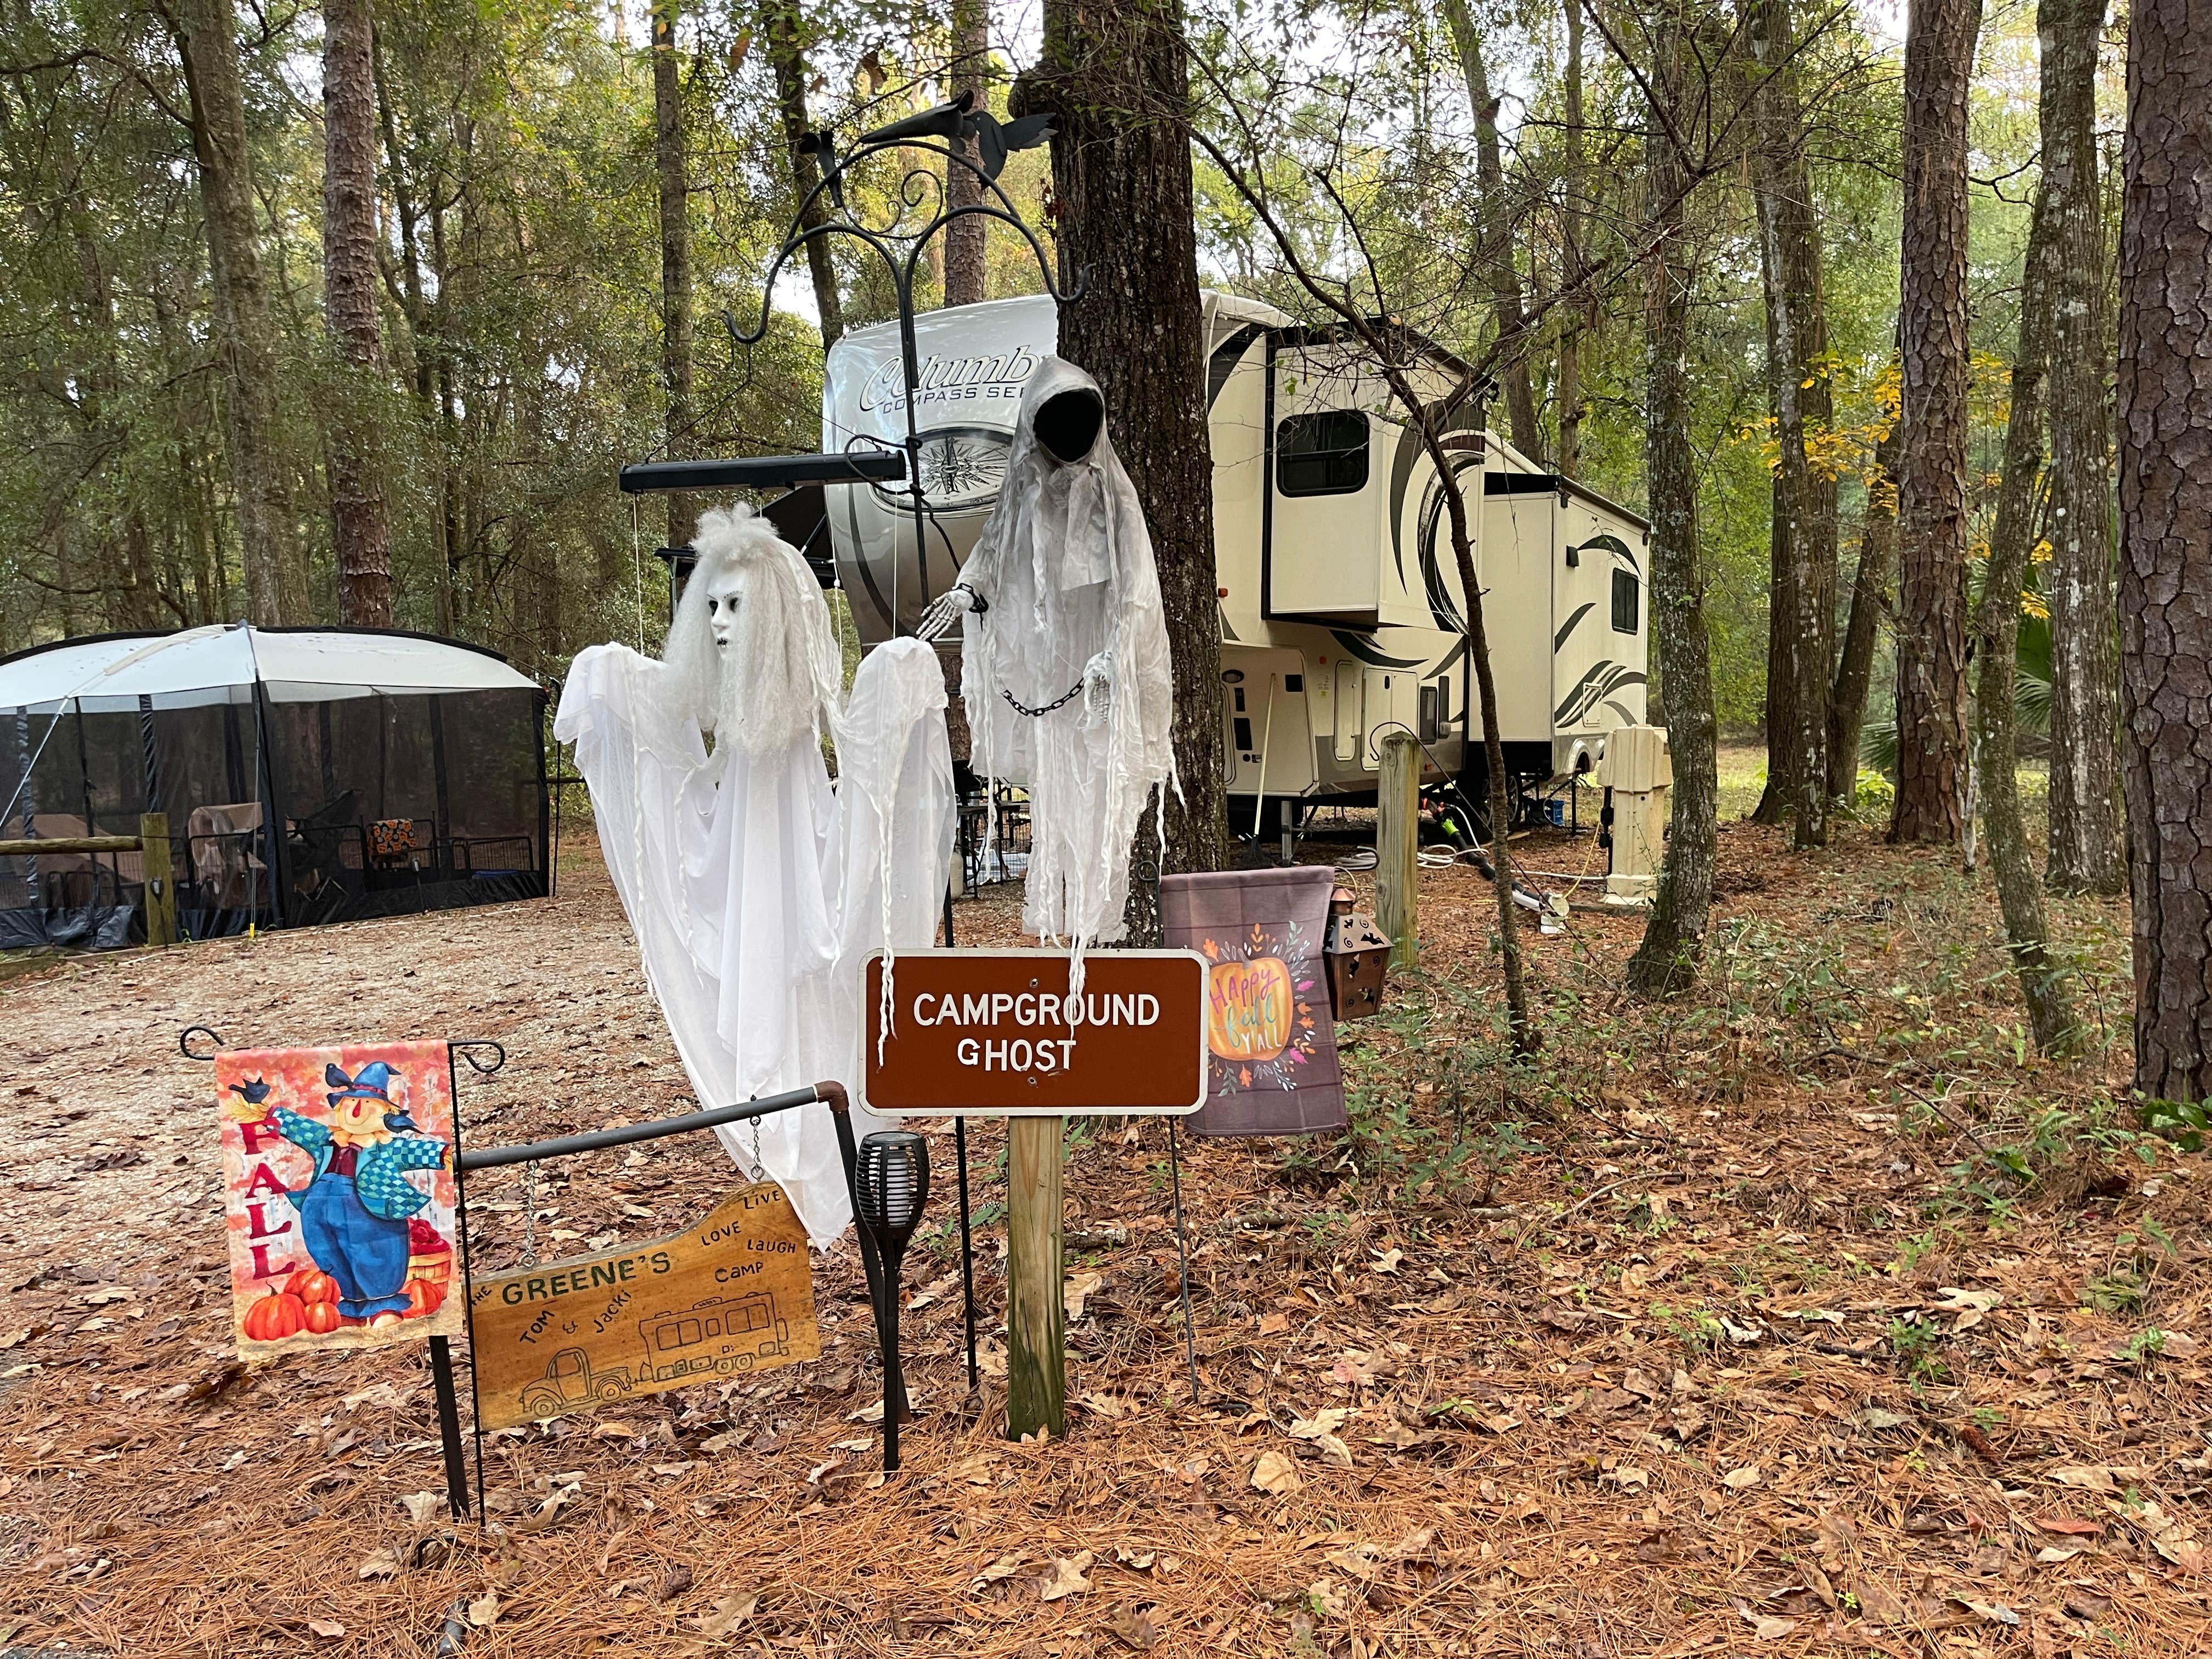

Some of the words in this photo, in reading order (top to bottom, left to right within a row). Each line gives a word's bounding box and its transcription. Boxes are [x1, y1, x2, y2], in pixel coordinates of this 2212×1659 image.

[860, 345, 1055, 411] Columb
[913, 993, 1160, 1026] CAMPGROUND
[1214, 992, 1277, 1048] fall
[957, 1038, 1076, 1072] GHOST
[1241, 1025, 1282, 1054] Y'ALL
[238, 1121, 296, 1280] FALL
[701, 1221, 742, 1246] LOVE
[502, 1251, 671, 1305] GREENE'S
[519, 1310, 555, 1344] TOM
[562, 1320, 579, 1334] &
